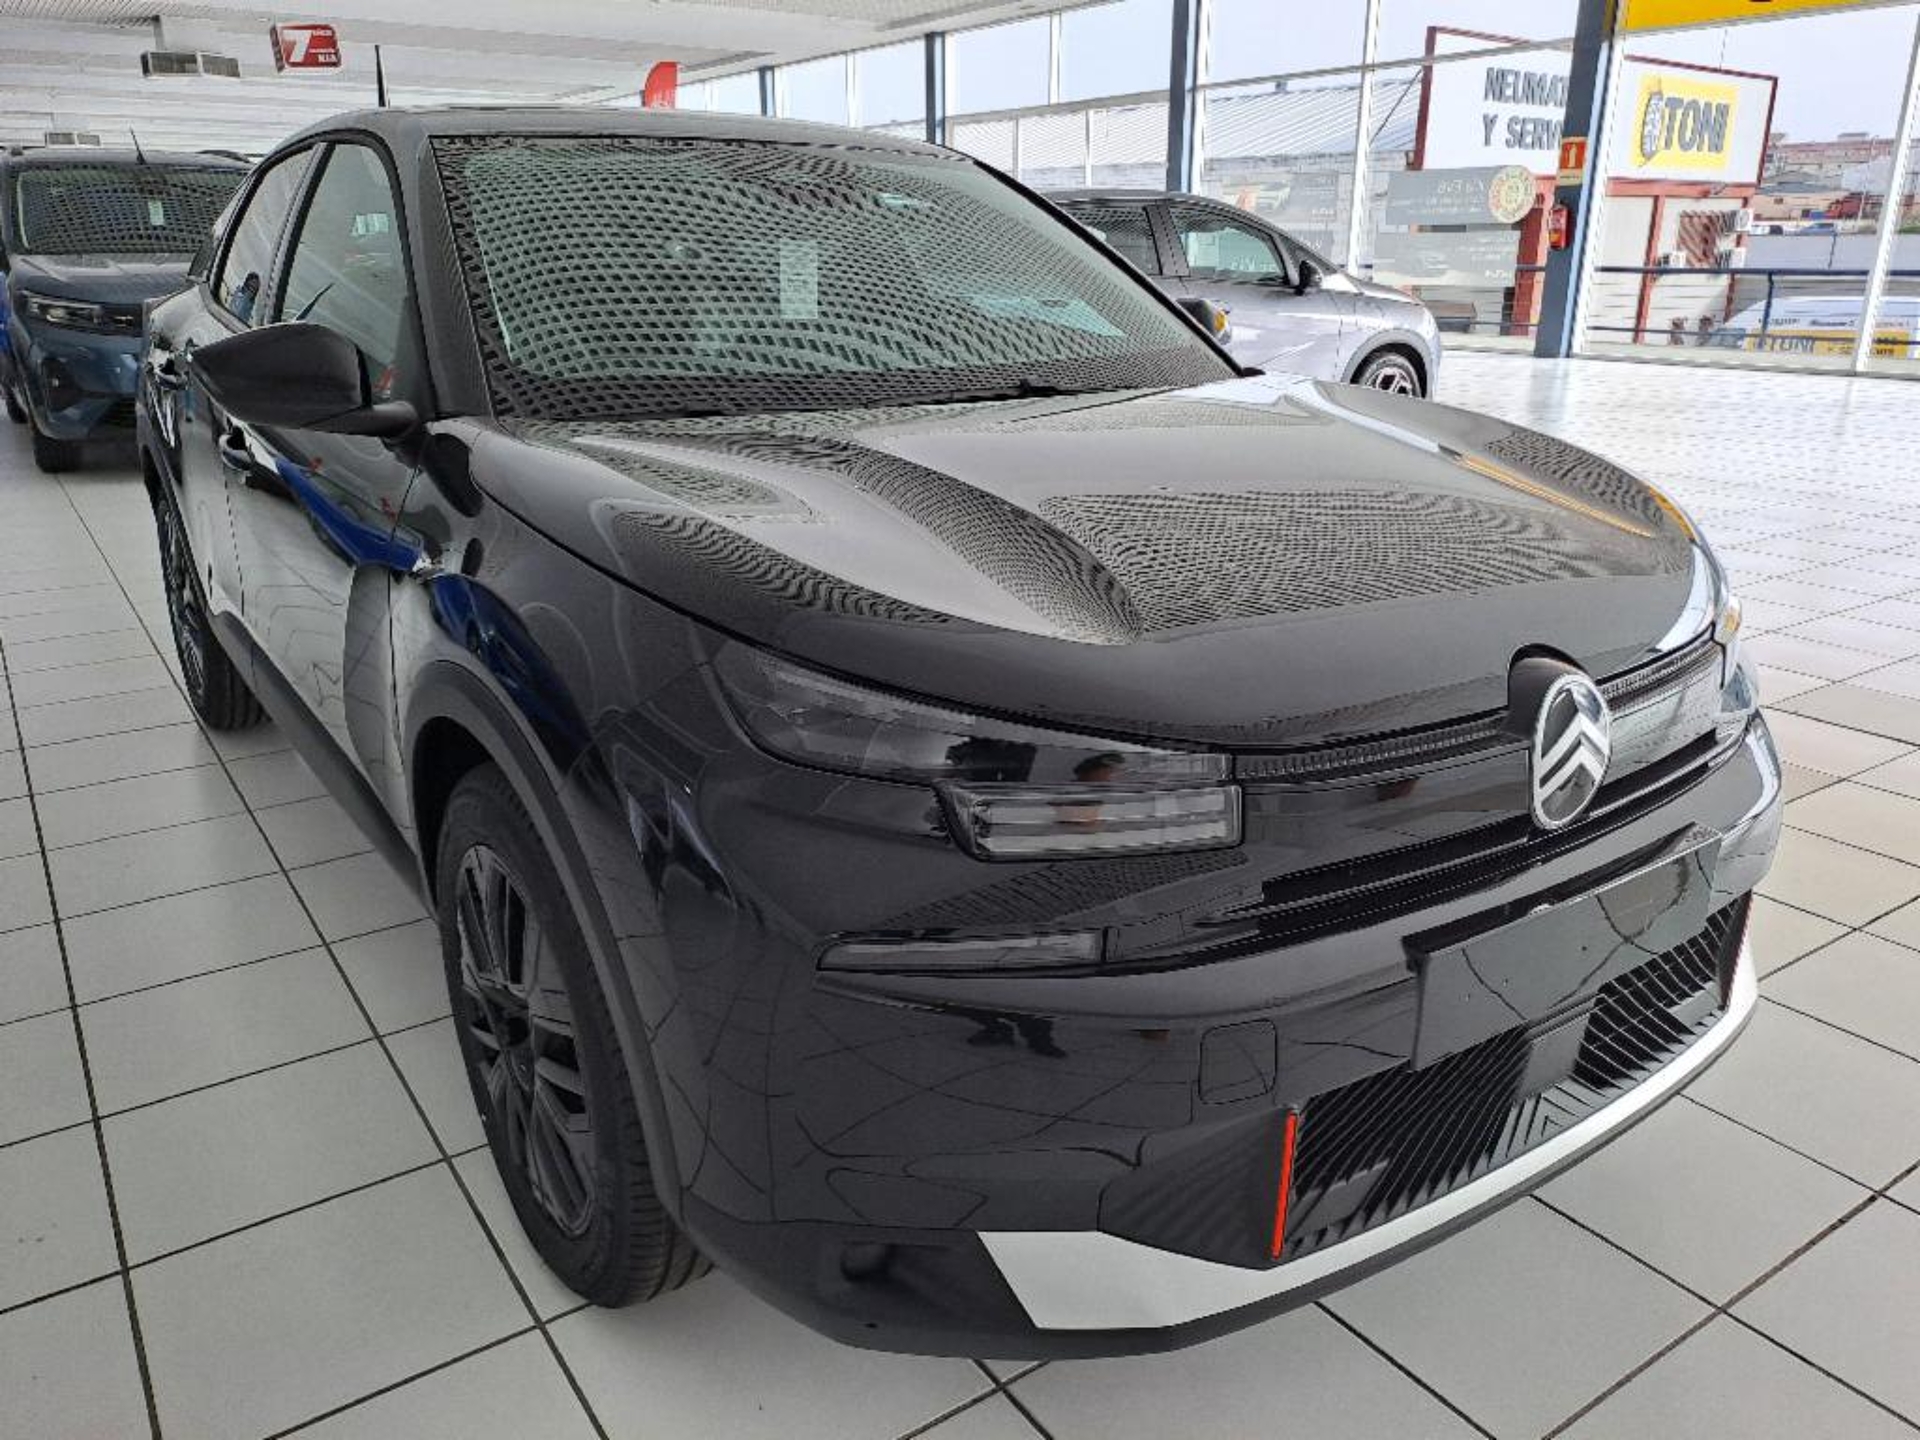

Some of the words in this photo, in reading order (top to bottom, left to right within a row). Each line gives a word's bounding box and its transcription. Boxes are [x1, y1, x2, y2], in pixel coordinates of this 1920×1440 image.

[282, 29, 313, 62] 7
[1483, 113, 1498, 146] Y
[1664, 97, 1729, 153] TONI
